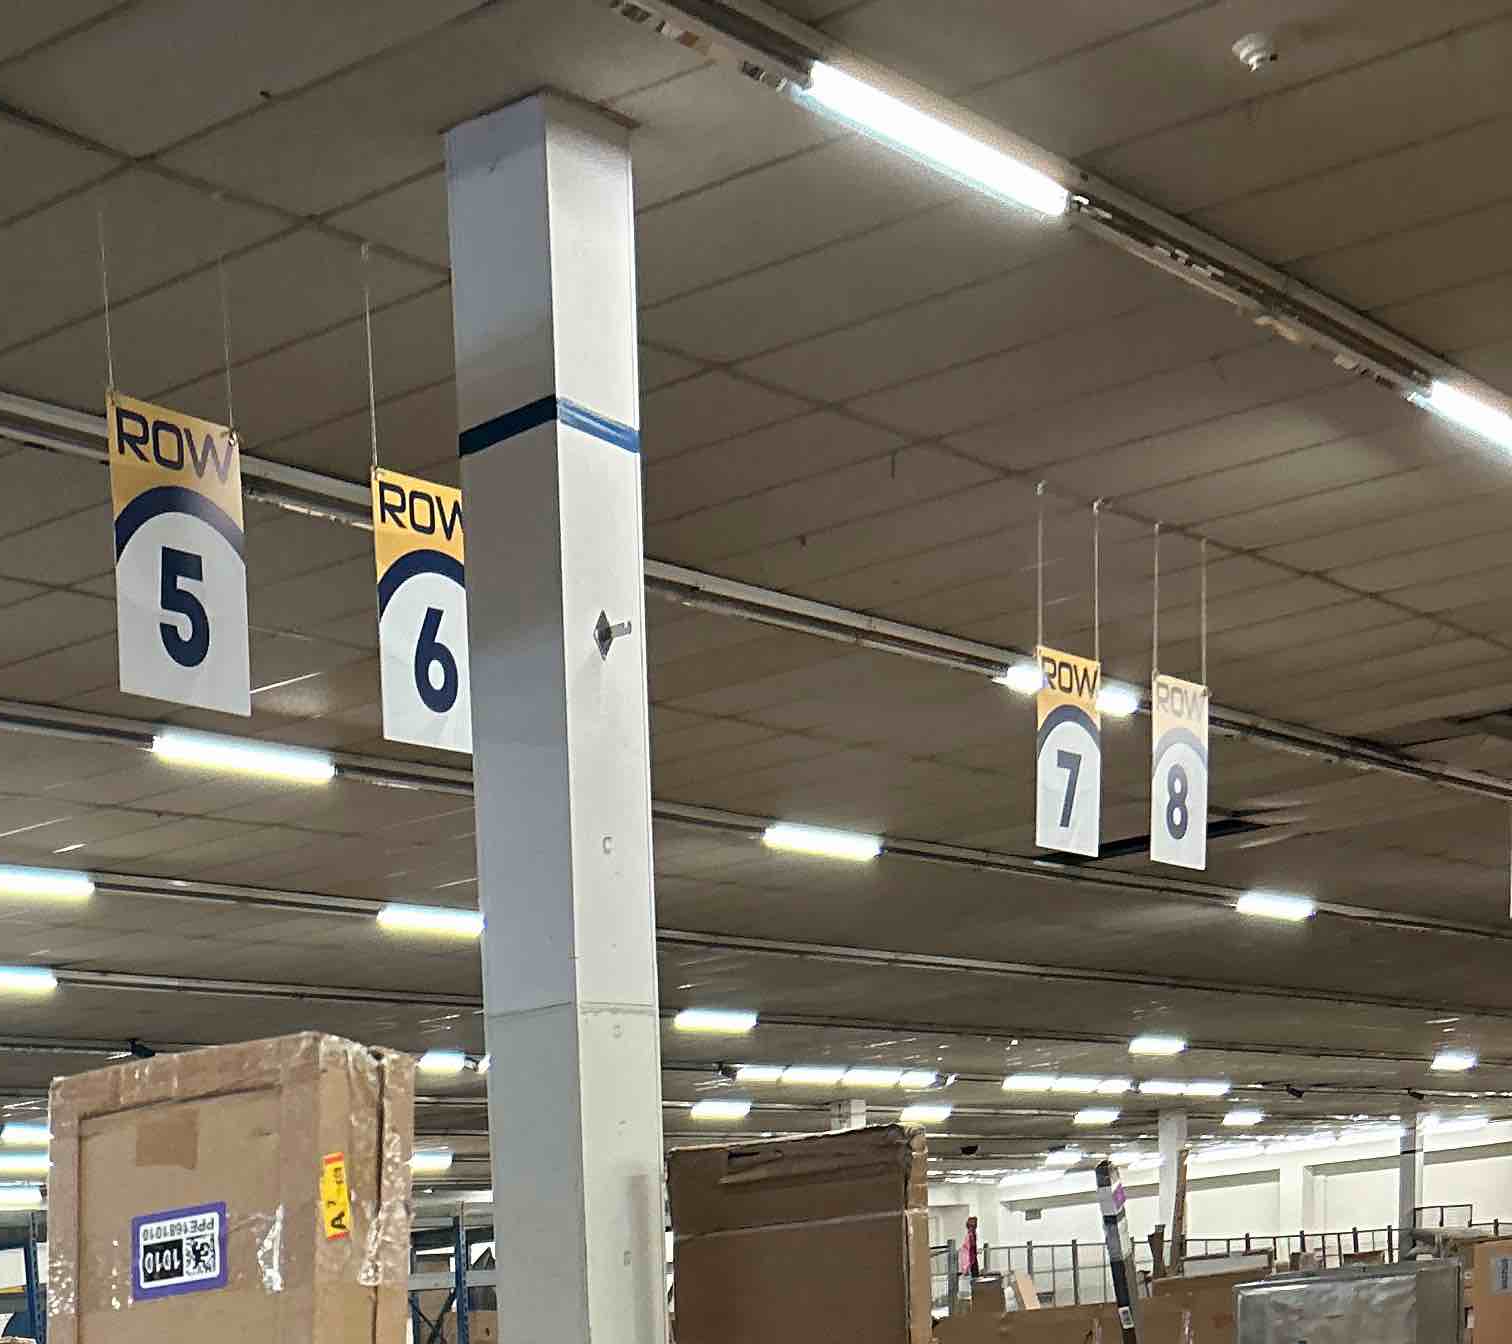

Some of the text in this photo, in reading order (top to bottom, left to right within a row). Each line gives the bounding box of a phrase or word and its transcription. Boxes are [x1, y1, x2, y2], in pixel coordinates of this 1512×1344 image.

[115, 406, 234, 484] ROW
[159, 545, 210, 667] 5
[414, 606, 459, 713] 6
[1041, 657, 1099, 699] ROW
[1156, 682, 1204, 720] ROW
[1057, 749, 1082, 828] 7
[1167, 764, 1188, 839] 8
[144, 1248, 180, 1274] 1010
